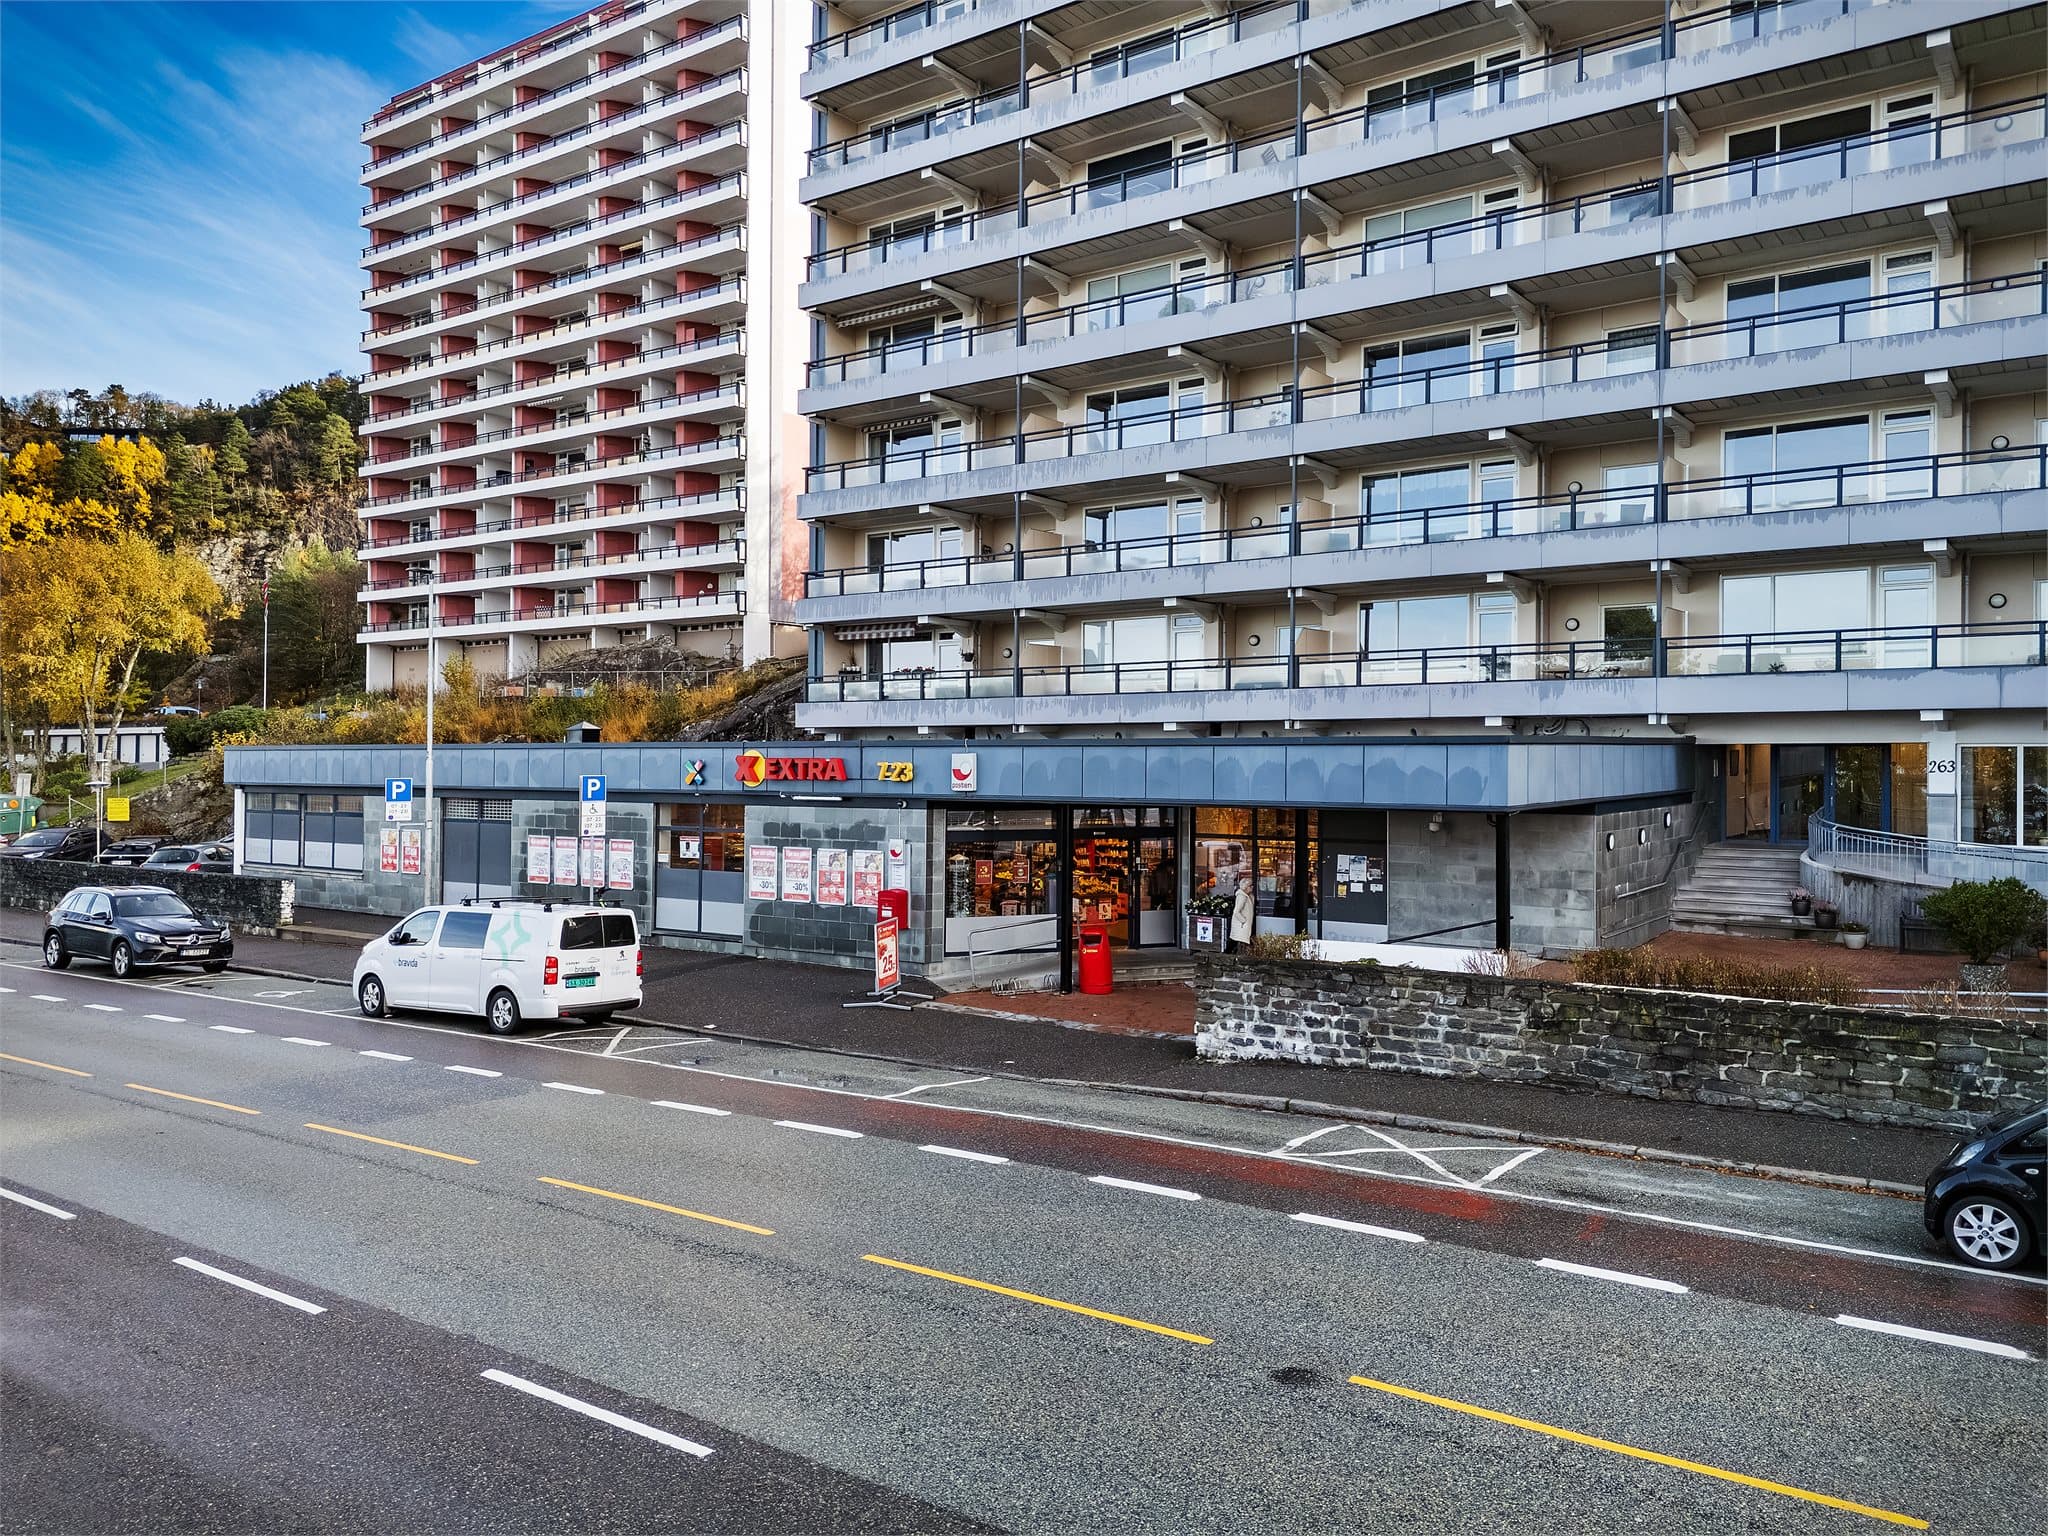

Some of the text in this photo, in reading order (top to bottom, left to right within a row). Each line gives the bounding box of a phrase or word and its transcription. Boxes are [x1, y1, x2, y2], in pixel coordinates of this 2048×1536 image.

[765, 757, 848, 781] EXTRA
[876, 761, 914, 782] 7-23
[1928, 760, 1955, 773] 263
[391, 781, 406, 800] P
[587, 778, 601, 799] P
[952, 782, 973, 790] posten
[792, 882, 808, 892] -30%
